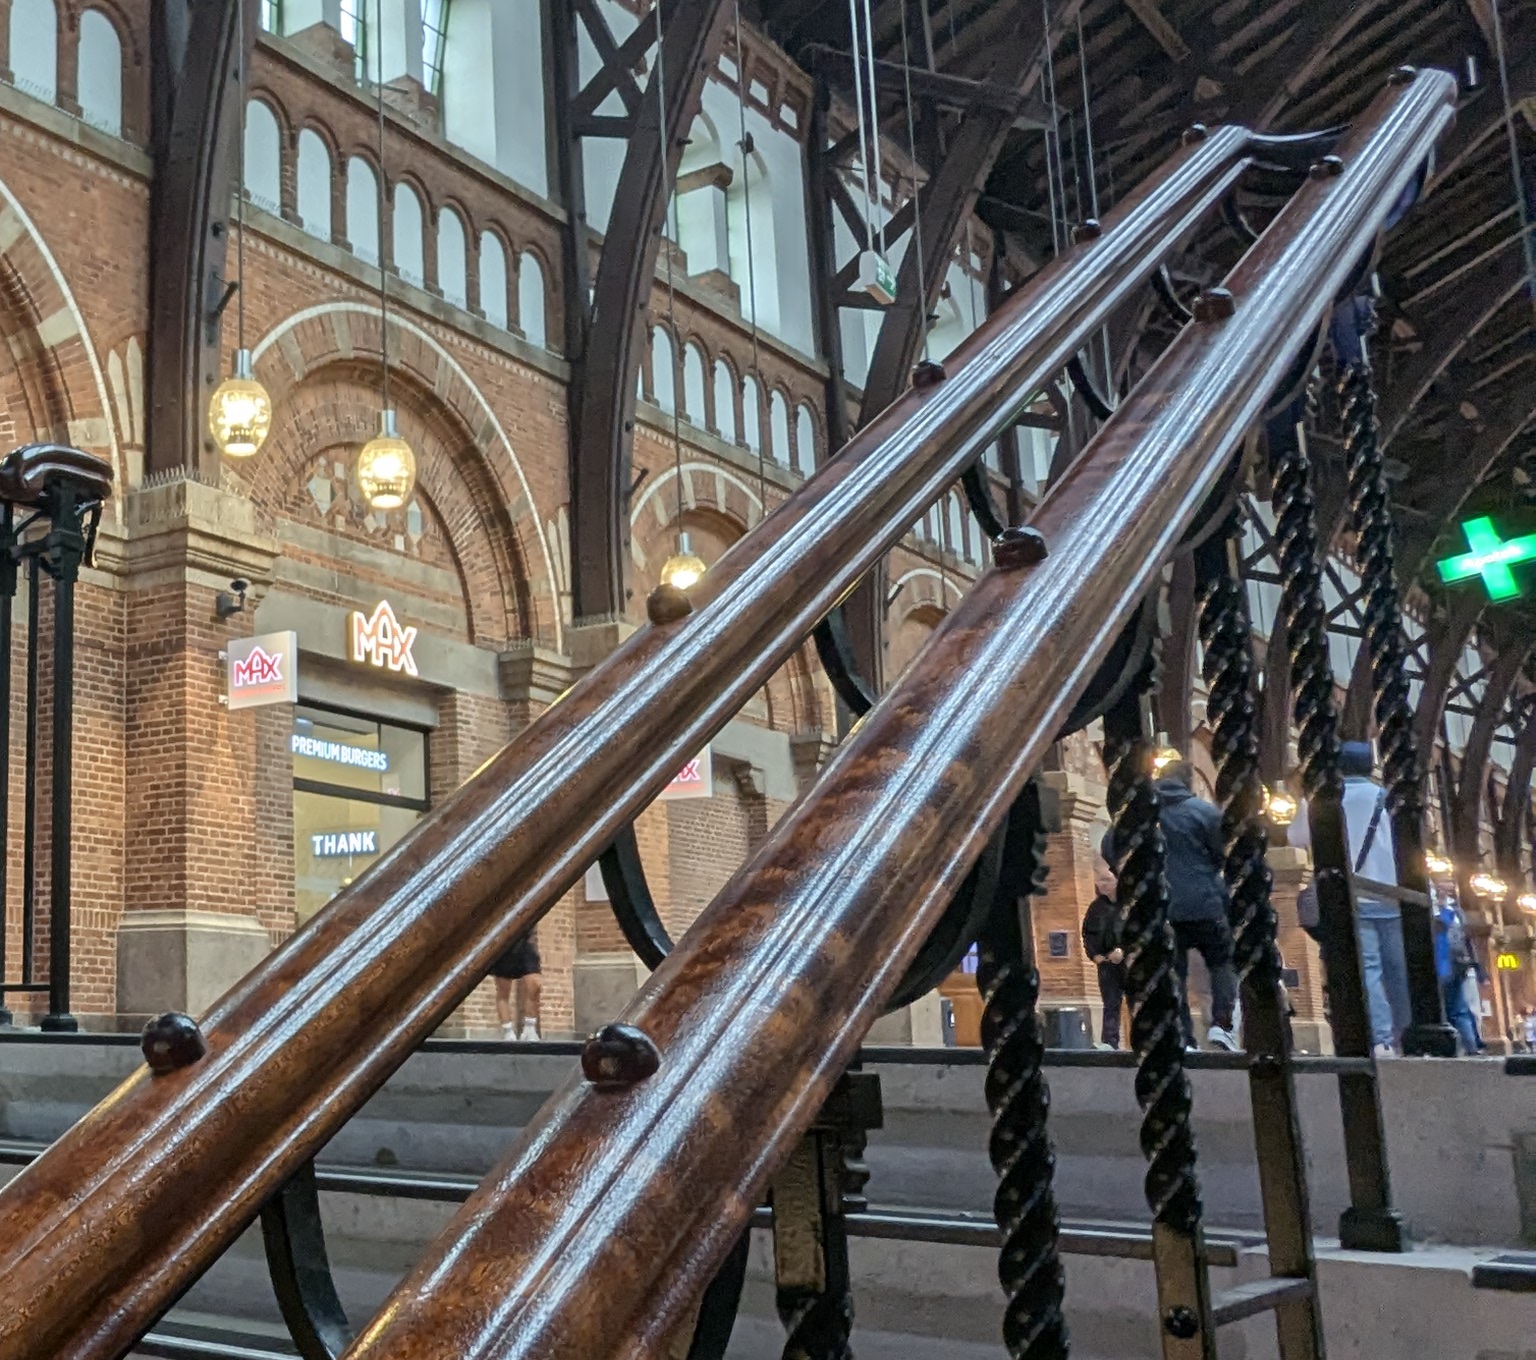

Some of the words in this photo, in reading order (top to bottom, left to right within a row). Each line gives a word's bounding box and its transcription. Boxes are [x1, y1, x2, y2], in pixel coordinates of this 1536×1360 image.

[350, 599, 419, 677] MAX
[233, 645, 284, 688] MAX
[291, 734, 340, 762] PREMIUM
[340, 746, 388, 771] BURGERS
[312, 831, 376, 856] THANK
